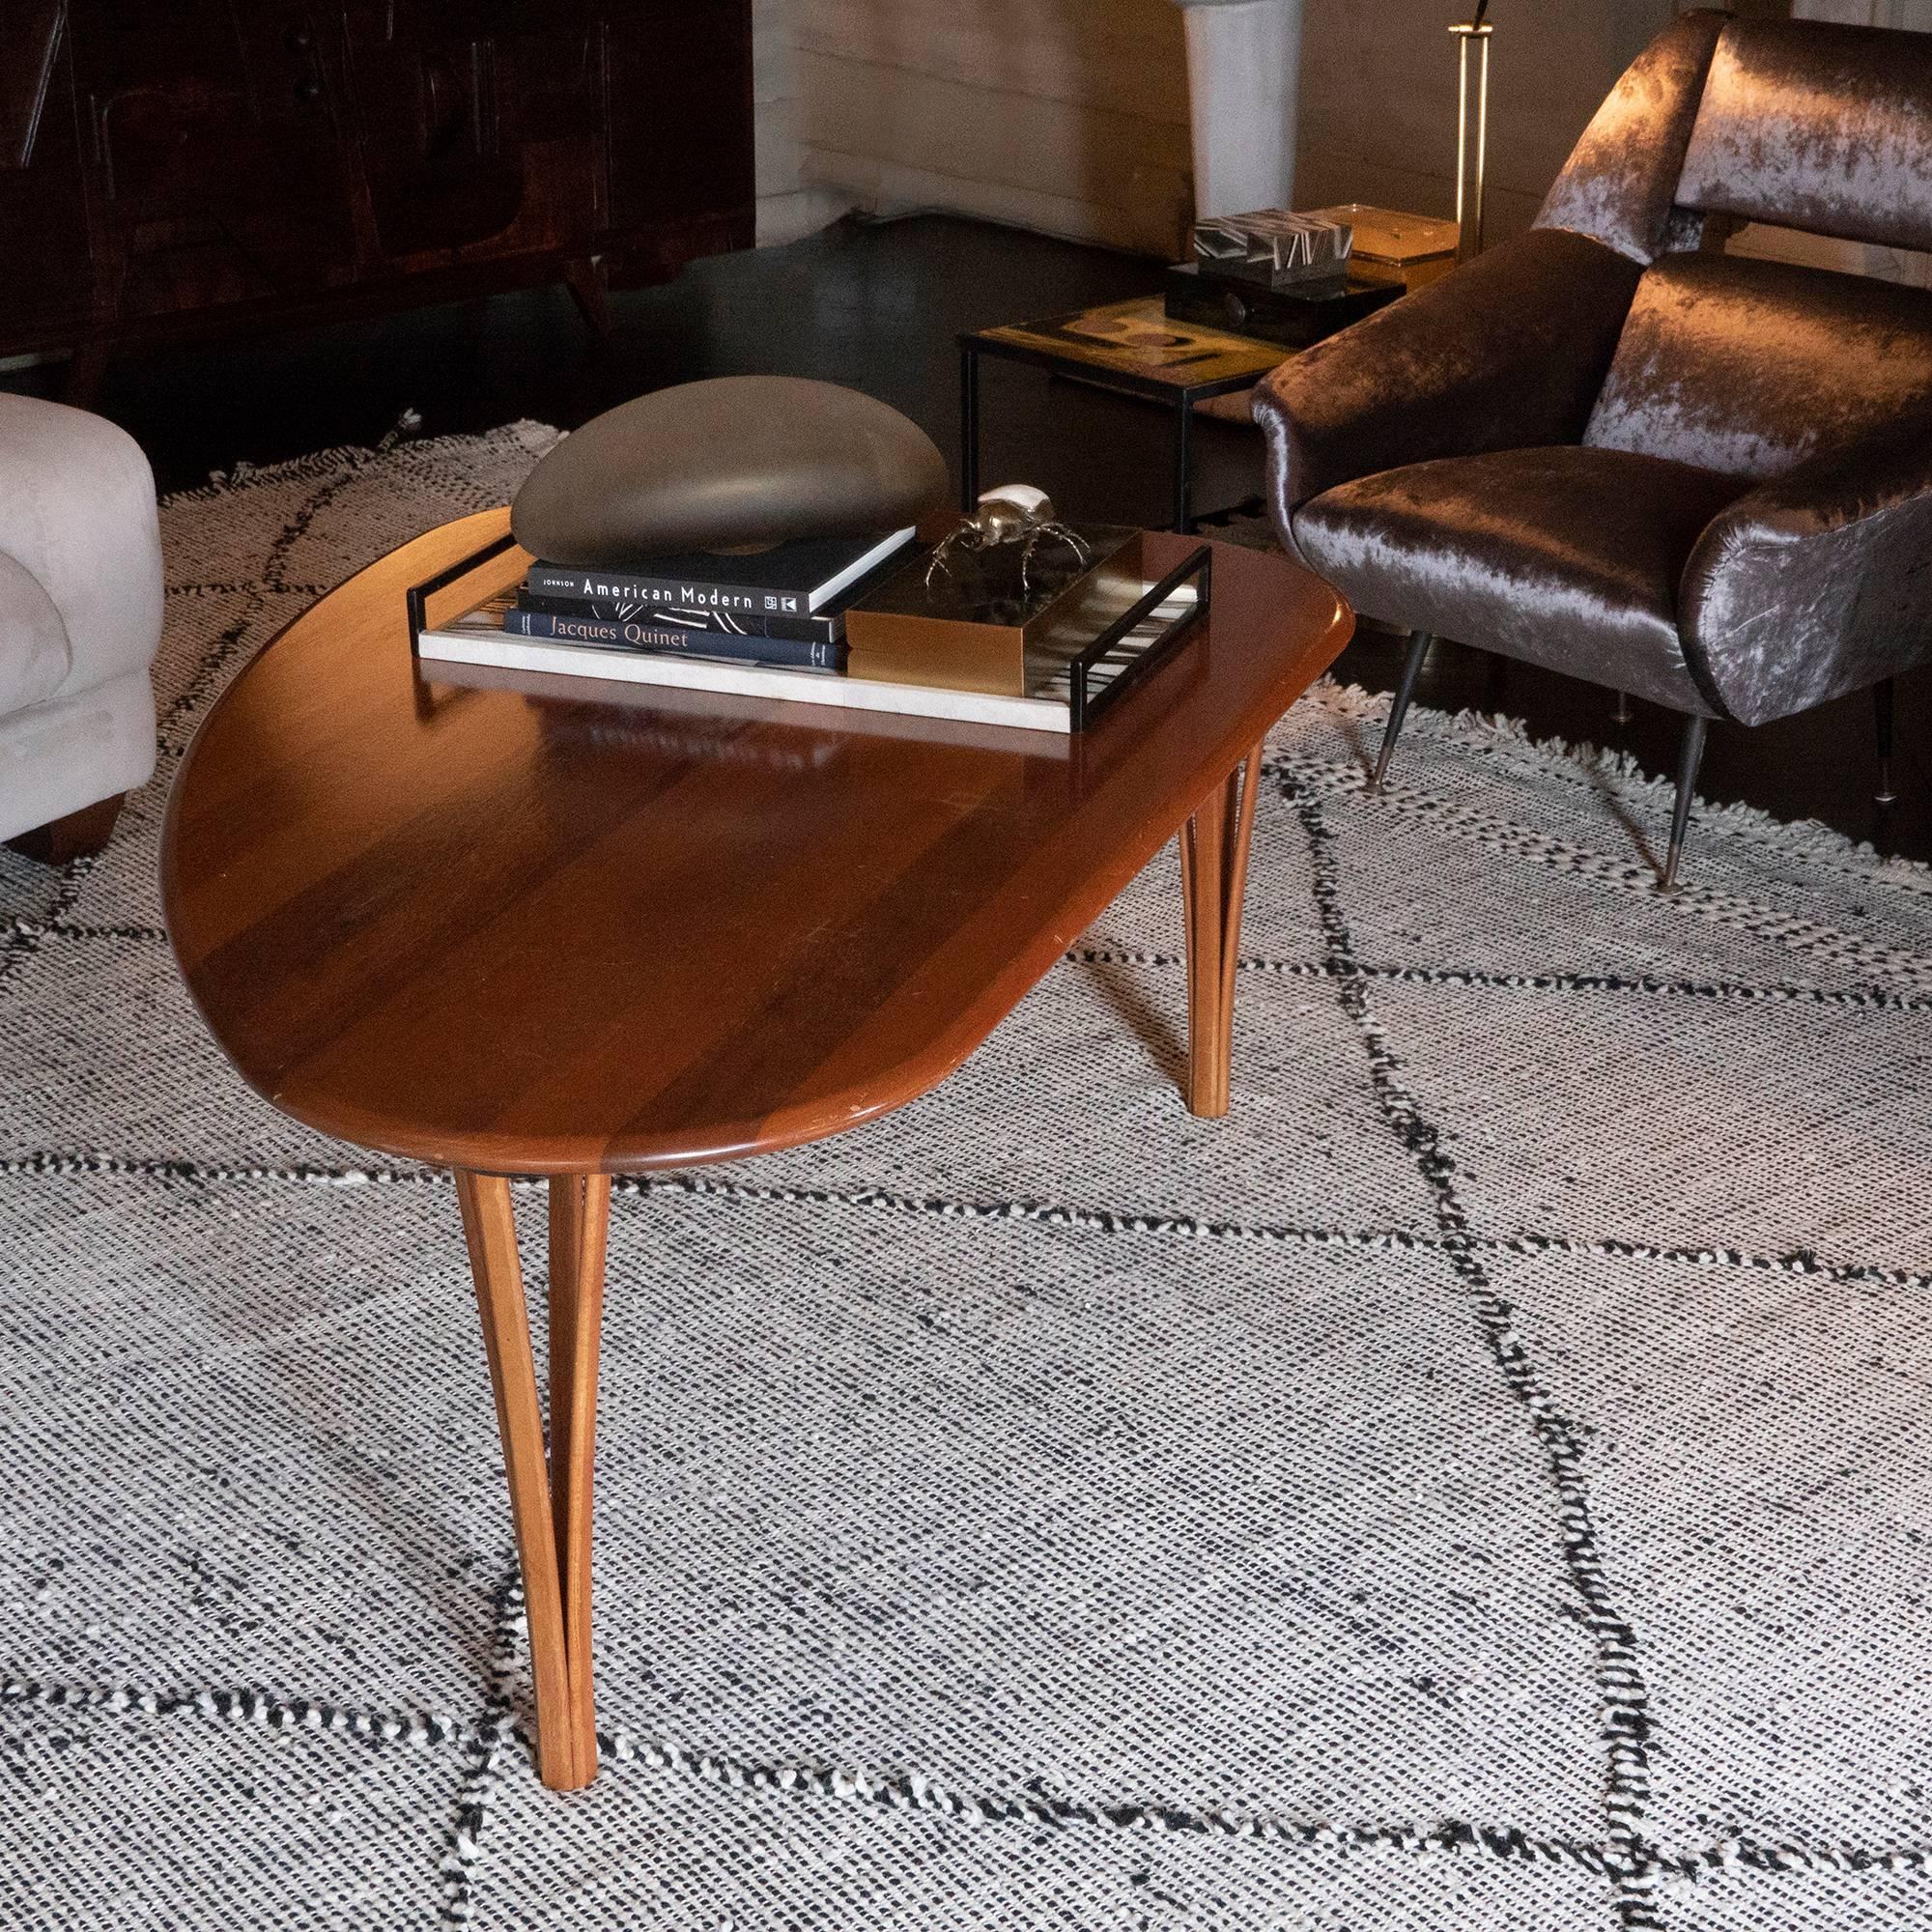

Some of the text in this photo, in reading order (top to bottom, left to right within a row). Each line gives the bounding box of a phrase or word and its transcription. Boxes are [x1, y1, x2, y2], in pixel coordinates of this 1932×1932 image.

[543, 579, 575, 587] JOHNSON
[582, 579, 672, 602] American
[681, 587, 753, 609] Modern
[550, 615, 617, 640] Jacques
[624, 623, 689, 647] Quinet
